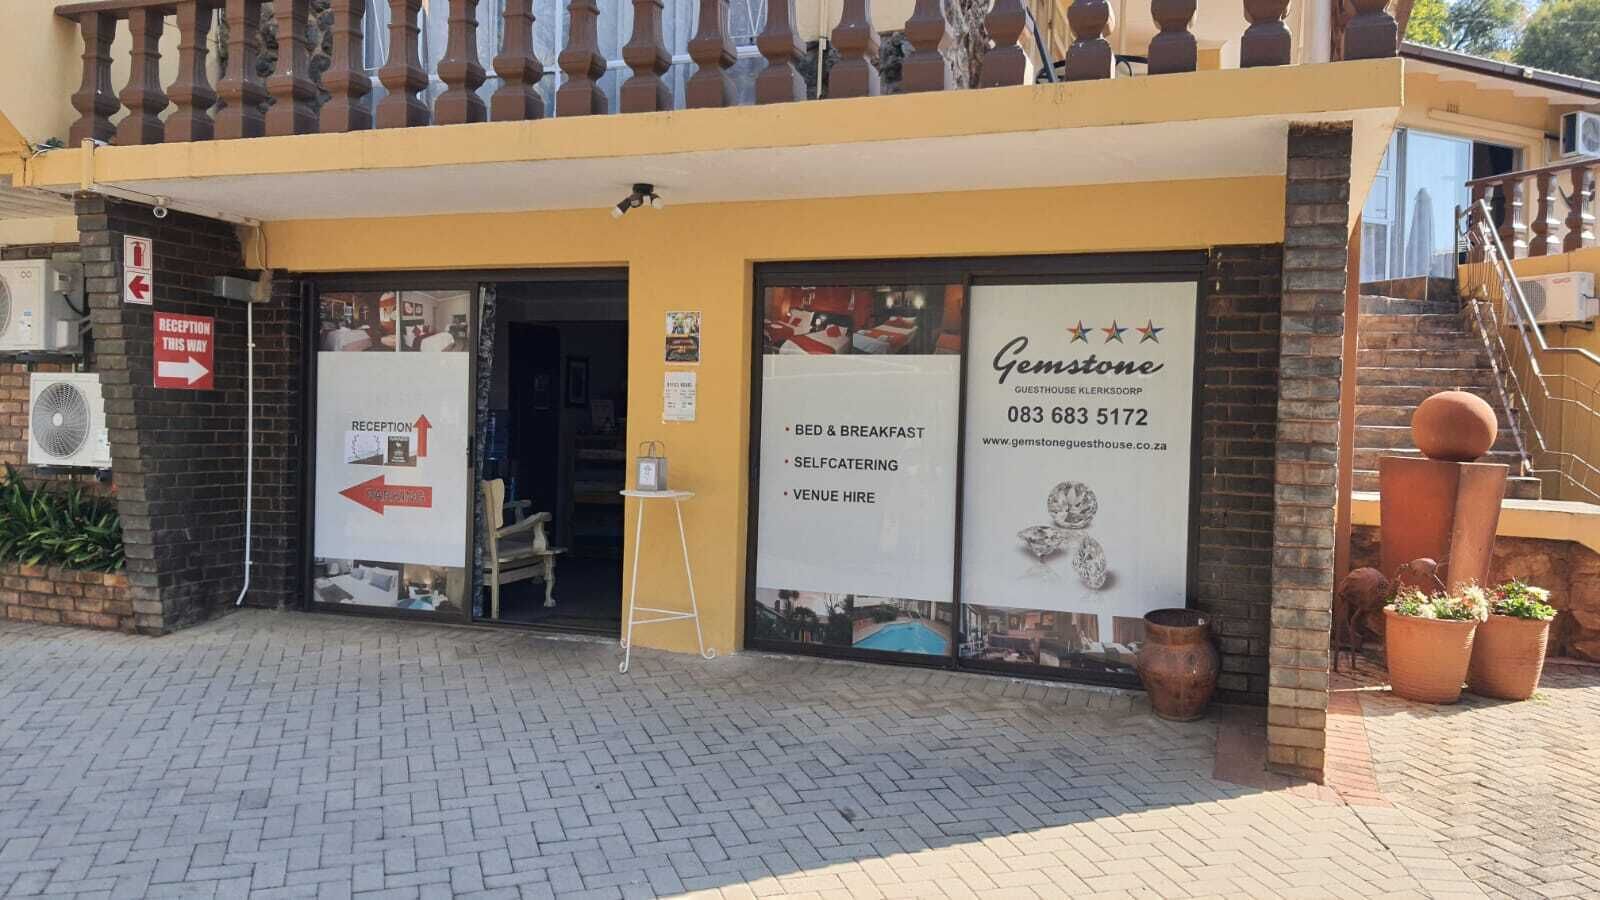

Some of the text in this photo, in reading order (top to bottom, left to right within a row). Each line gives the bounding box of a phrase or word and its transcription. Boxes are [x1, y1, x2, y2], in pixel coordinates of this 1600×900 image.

[159, 318, 210, 335] RECEPTION
[162, 336, 208, 352] THIS WAY
[992, 336, 1164, 384] Gemstone
[1014, 385, 1143, 396] GUESTHOUSE KLERKSDORP
[1007, 405, 1149, 426] 083 683 5172
[351, 420, 412, 433] RECEPTION
[795, 424, 925, 439] BED & BREAKFAST
[982, 435, 1167, 451] www.gemstoneguesthouse.co.za
[793, 456, 899, 472] SELFCATERING
[793, 488, 876, 504] VENUE HIRE
